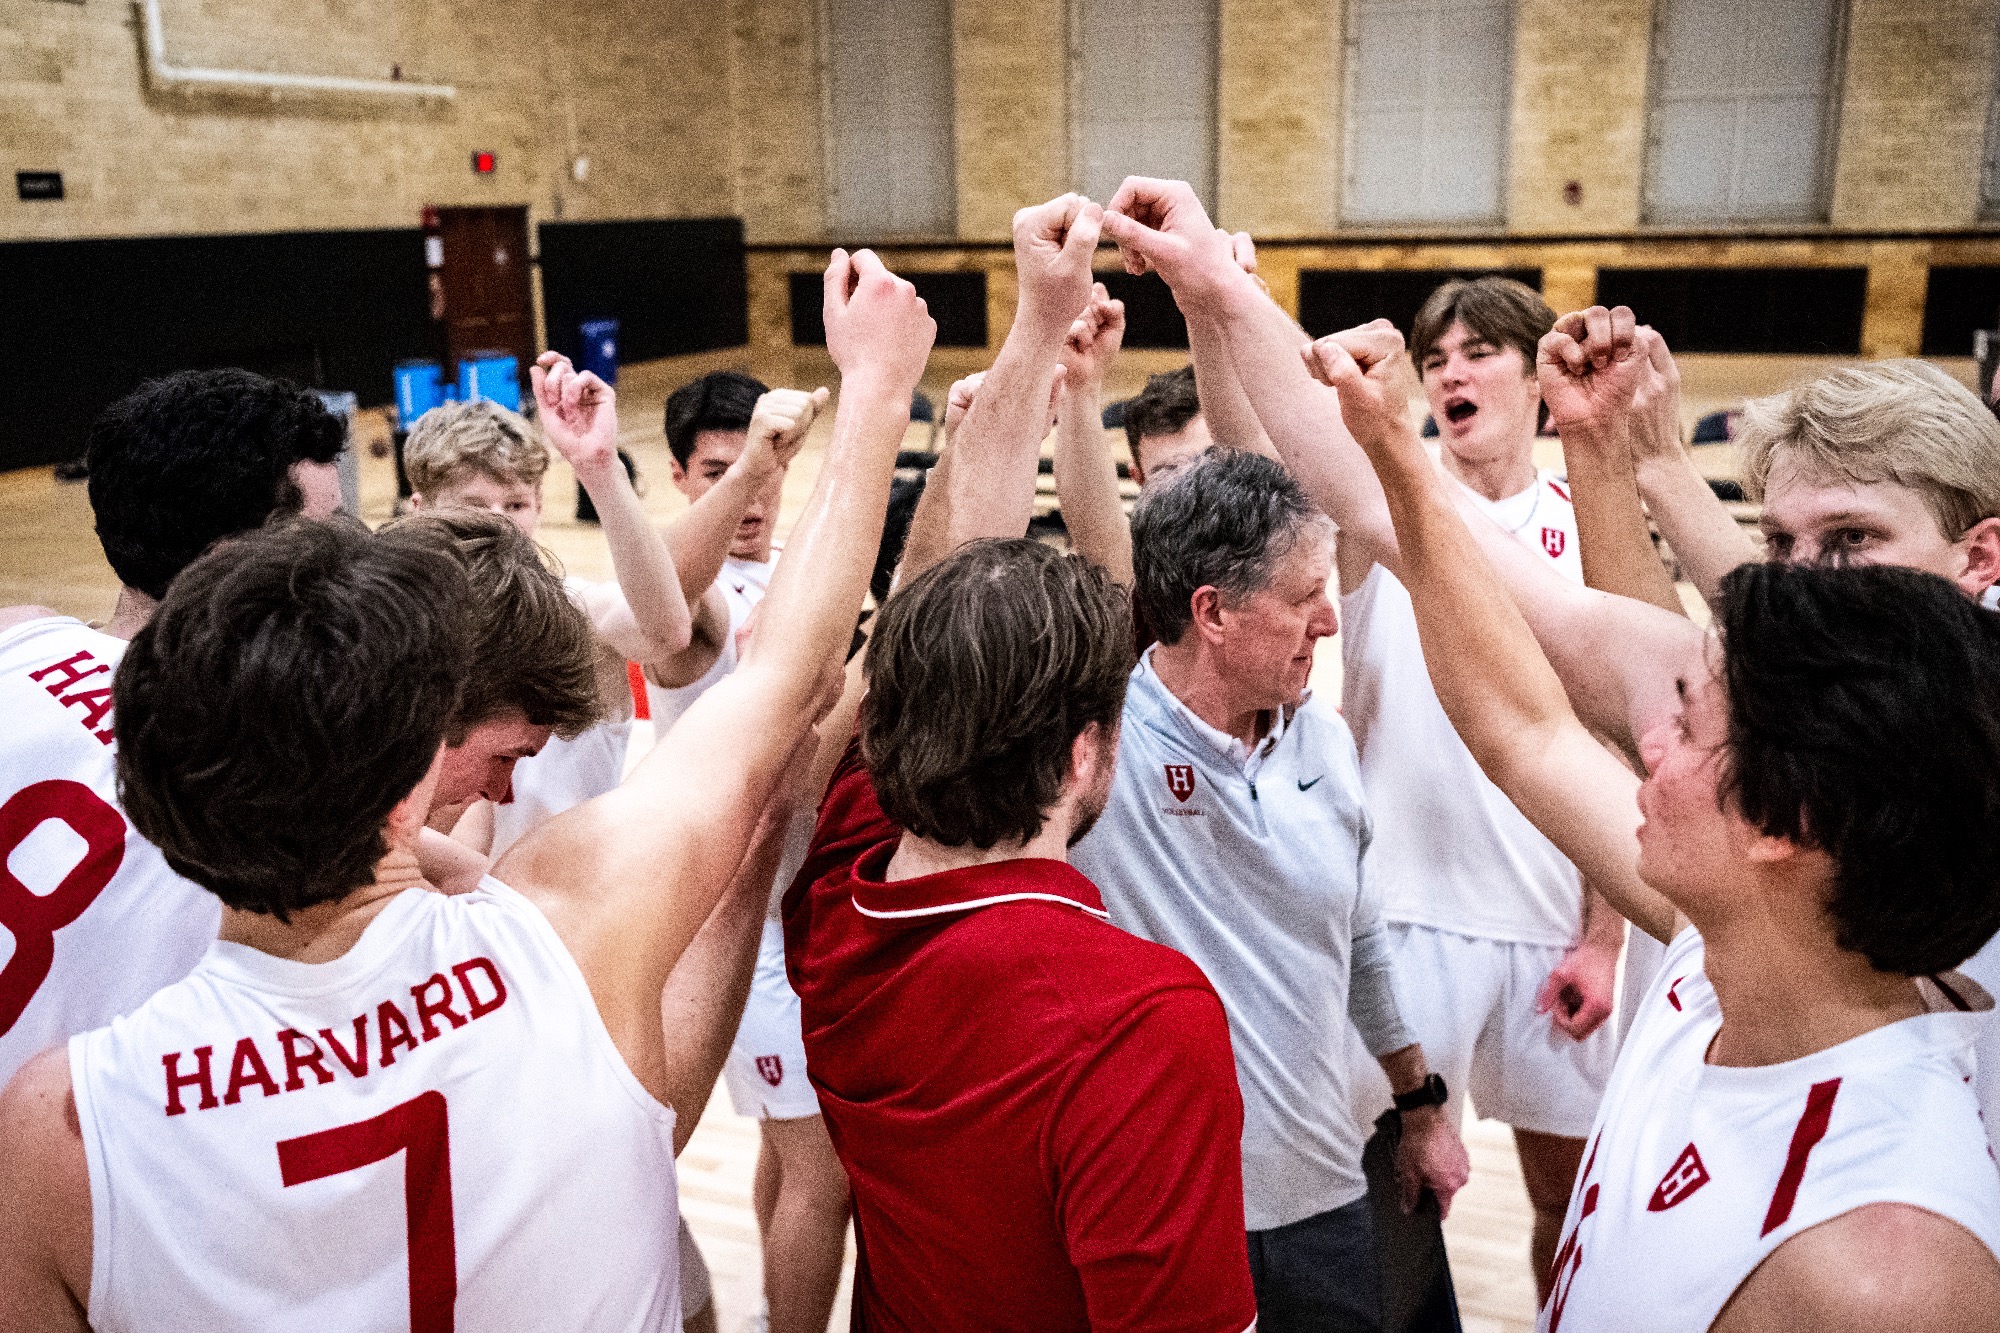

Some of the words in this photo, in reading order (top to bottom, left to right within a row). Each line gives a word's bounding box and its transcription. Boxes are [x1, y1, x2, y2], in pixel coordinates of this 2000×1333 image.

[1169, 767, 1191, 792] H
[162, 957, 507, 1116] HARVARD
[276, 1090, 457, 1333] 7
[1661, 1154, 1701, 1204] H
